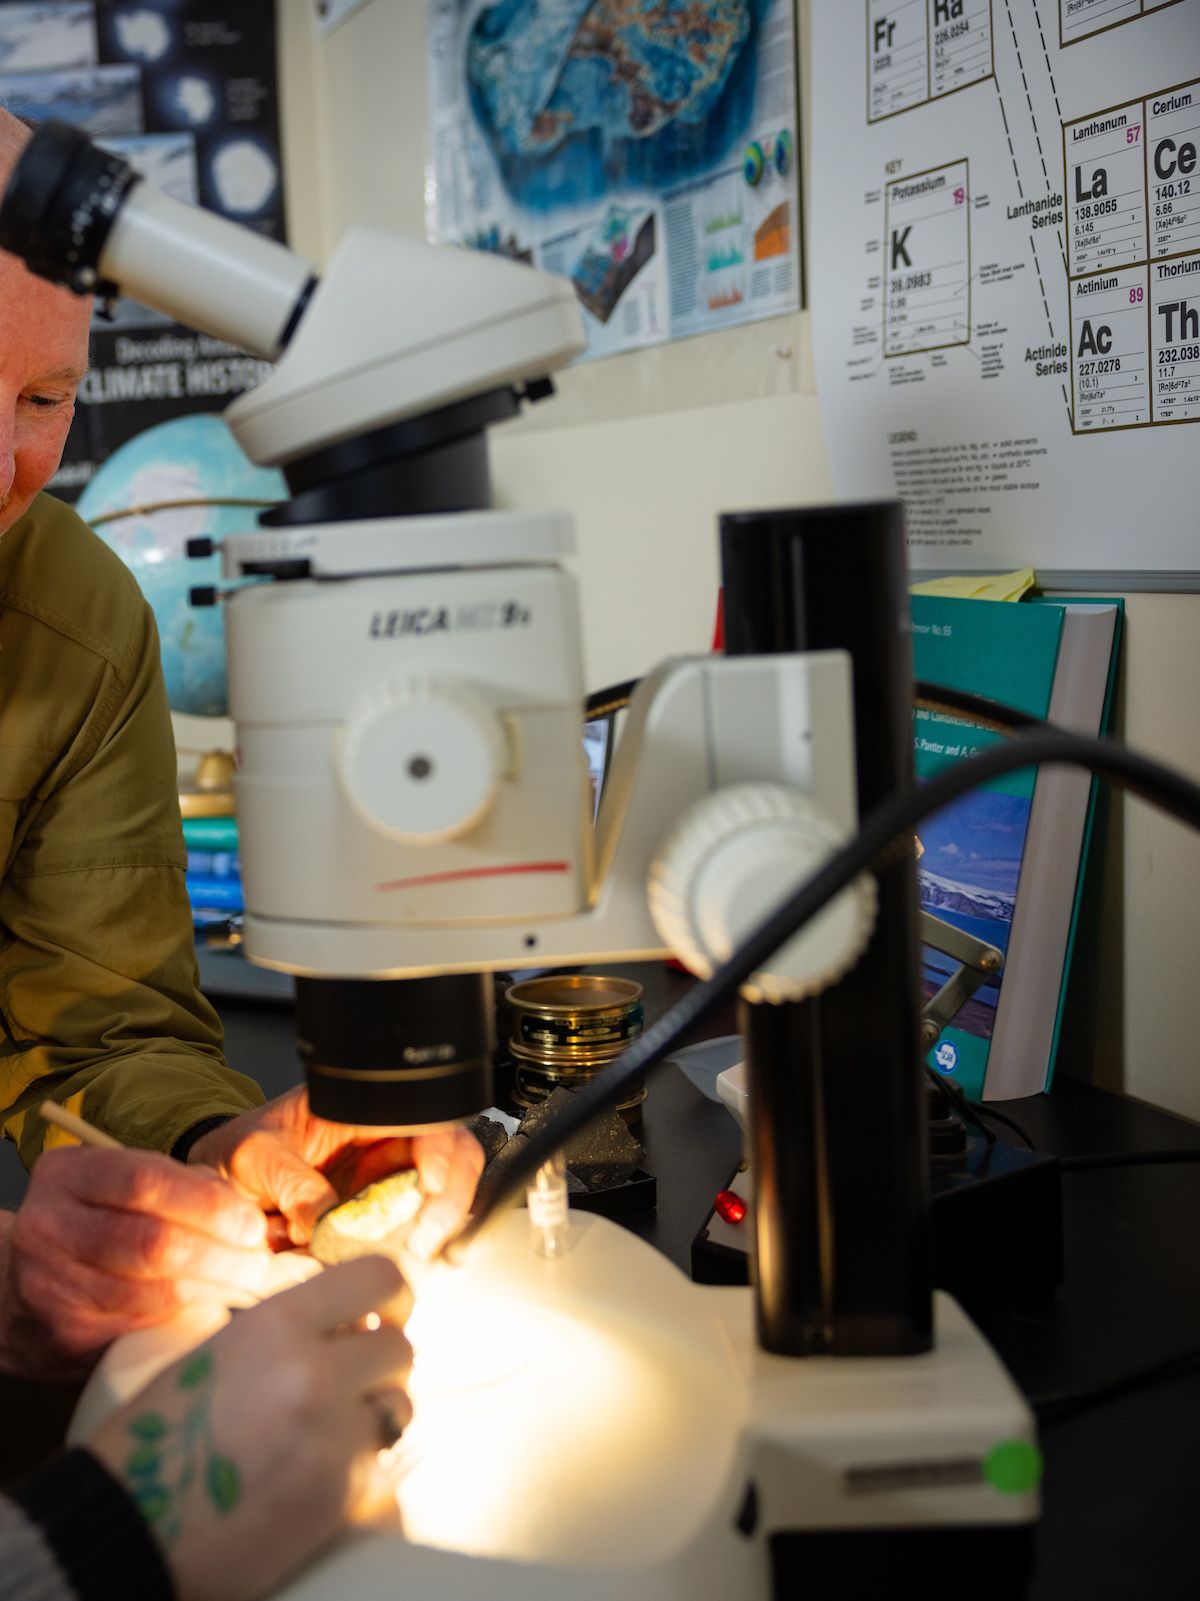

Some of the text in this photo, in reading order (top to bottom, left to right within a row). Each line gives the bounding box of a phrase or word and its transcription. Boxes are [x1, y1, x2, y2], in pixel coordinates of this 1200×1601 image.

[874, 16, 896, 53] Fr
[1152, 93, 1192, 115] Cerium
[1073, 114, 1127, 141] Lanthanum
[1126, 125, 1141, 144] 57
[1154, 138, 1197, 180] Ce
[892, 175, 946, 200] Potassium
[1075, 165, 1108, 203] La
[1155, 179, 1191, 201] 140.12
[953, 187, 965, 206] 19
[1006, 192, 1063, 219] Lanthanide
[1031, 210, 1064, 230] Series
[1075, 199, 1118, 221] 138.9055
[1155, 203, 1173, 216] 6.66
[1074, 222, 1094, 236] 6.145
[891, 225, 913, 271] K
[1157, 261, 1200, 279] Thorium
[1076, 275, 1118, 296] Actinium
[1129, 287, 1144, 304] 89
[1158, 300, 1199, 343] Th
[115, 335, 196, 364] Decoding
[1077, 319, 1113, 359] Ac
[1025, 343, 1067, 362] Actinide
[1035, 361, 1068, 377] Series
[1079, 358, 1121, 376] 227.0278
[1158, 366, 1175, 378] 11.7
[79, 360, 184, 405] CLIMATE
[1079, 377, 1099, 390] (10.1)
[369, 605, 450, 641] LEICA
[945, 745, 960, 757] and
